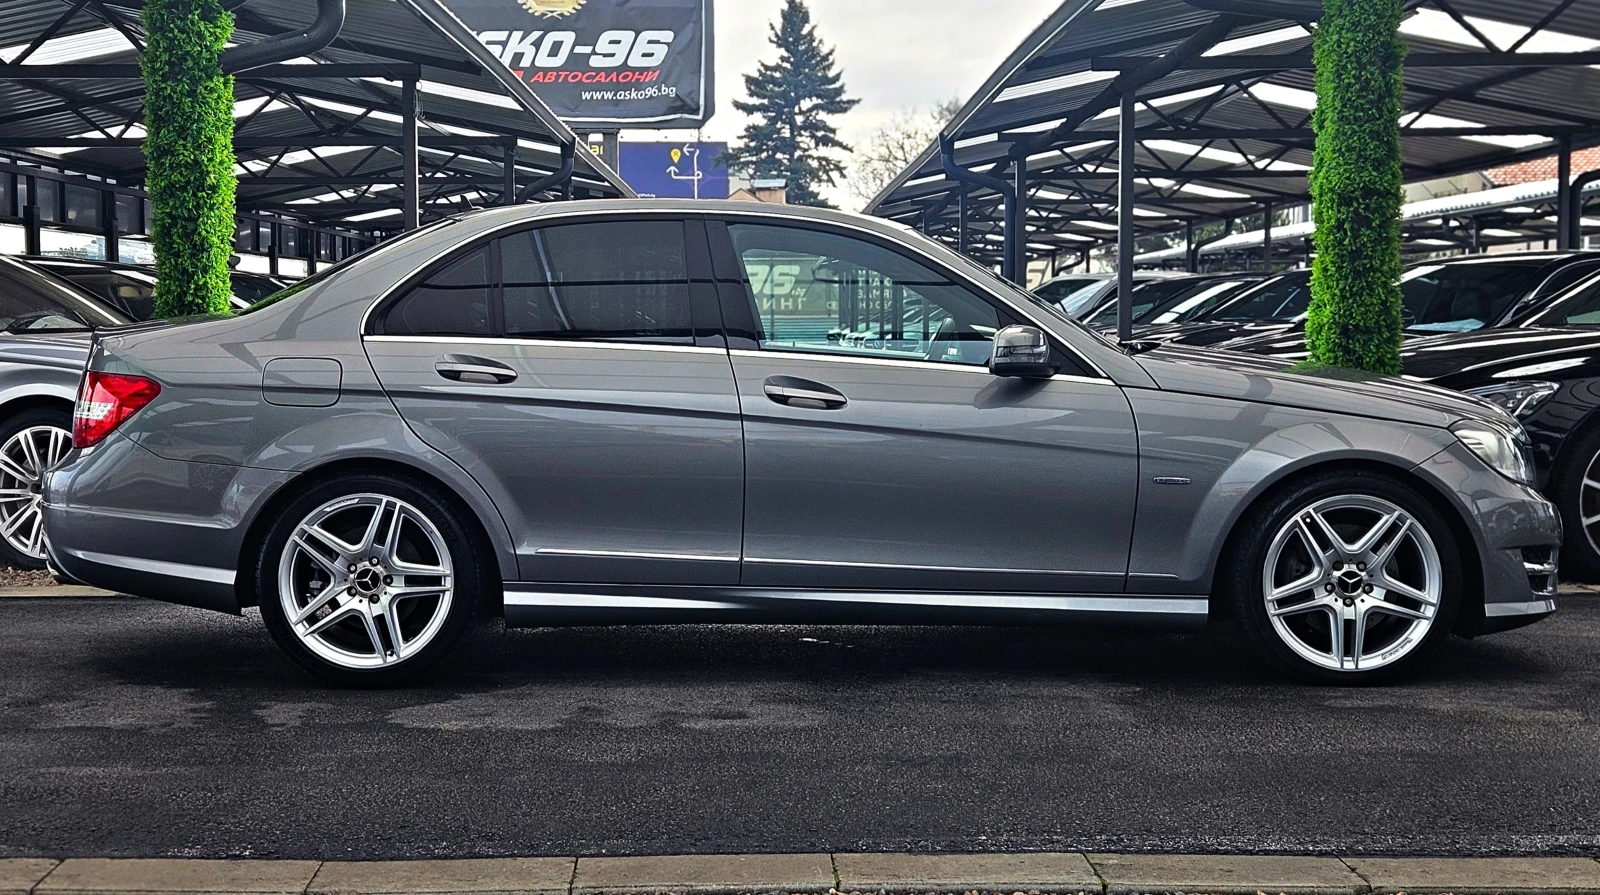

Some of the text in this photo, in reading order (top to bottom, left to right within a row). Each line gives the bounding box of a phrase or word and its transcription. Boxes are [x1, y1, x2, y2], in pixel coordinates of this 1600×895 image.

[471, 30, 675, 68] SKO-96
[530, 70, 660, 83] АВТОСАЛОНИ
[581, 84, 676, 100] www.asko96.bg
[755, 297, 807, 310] ИНГ
